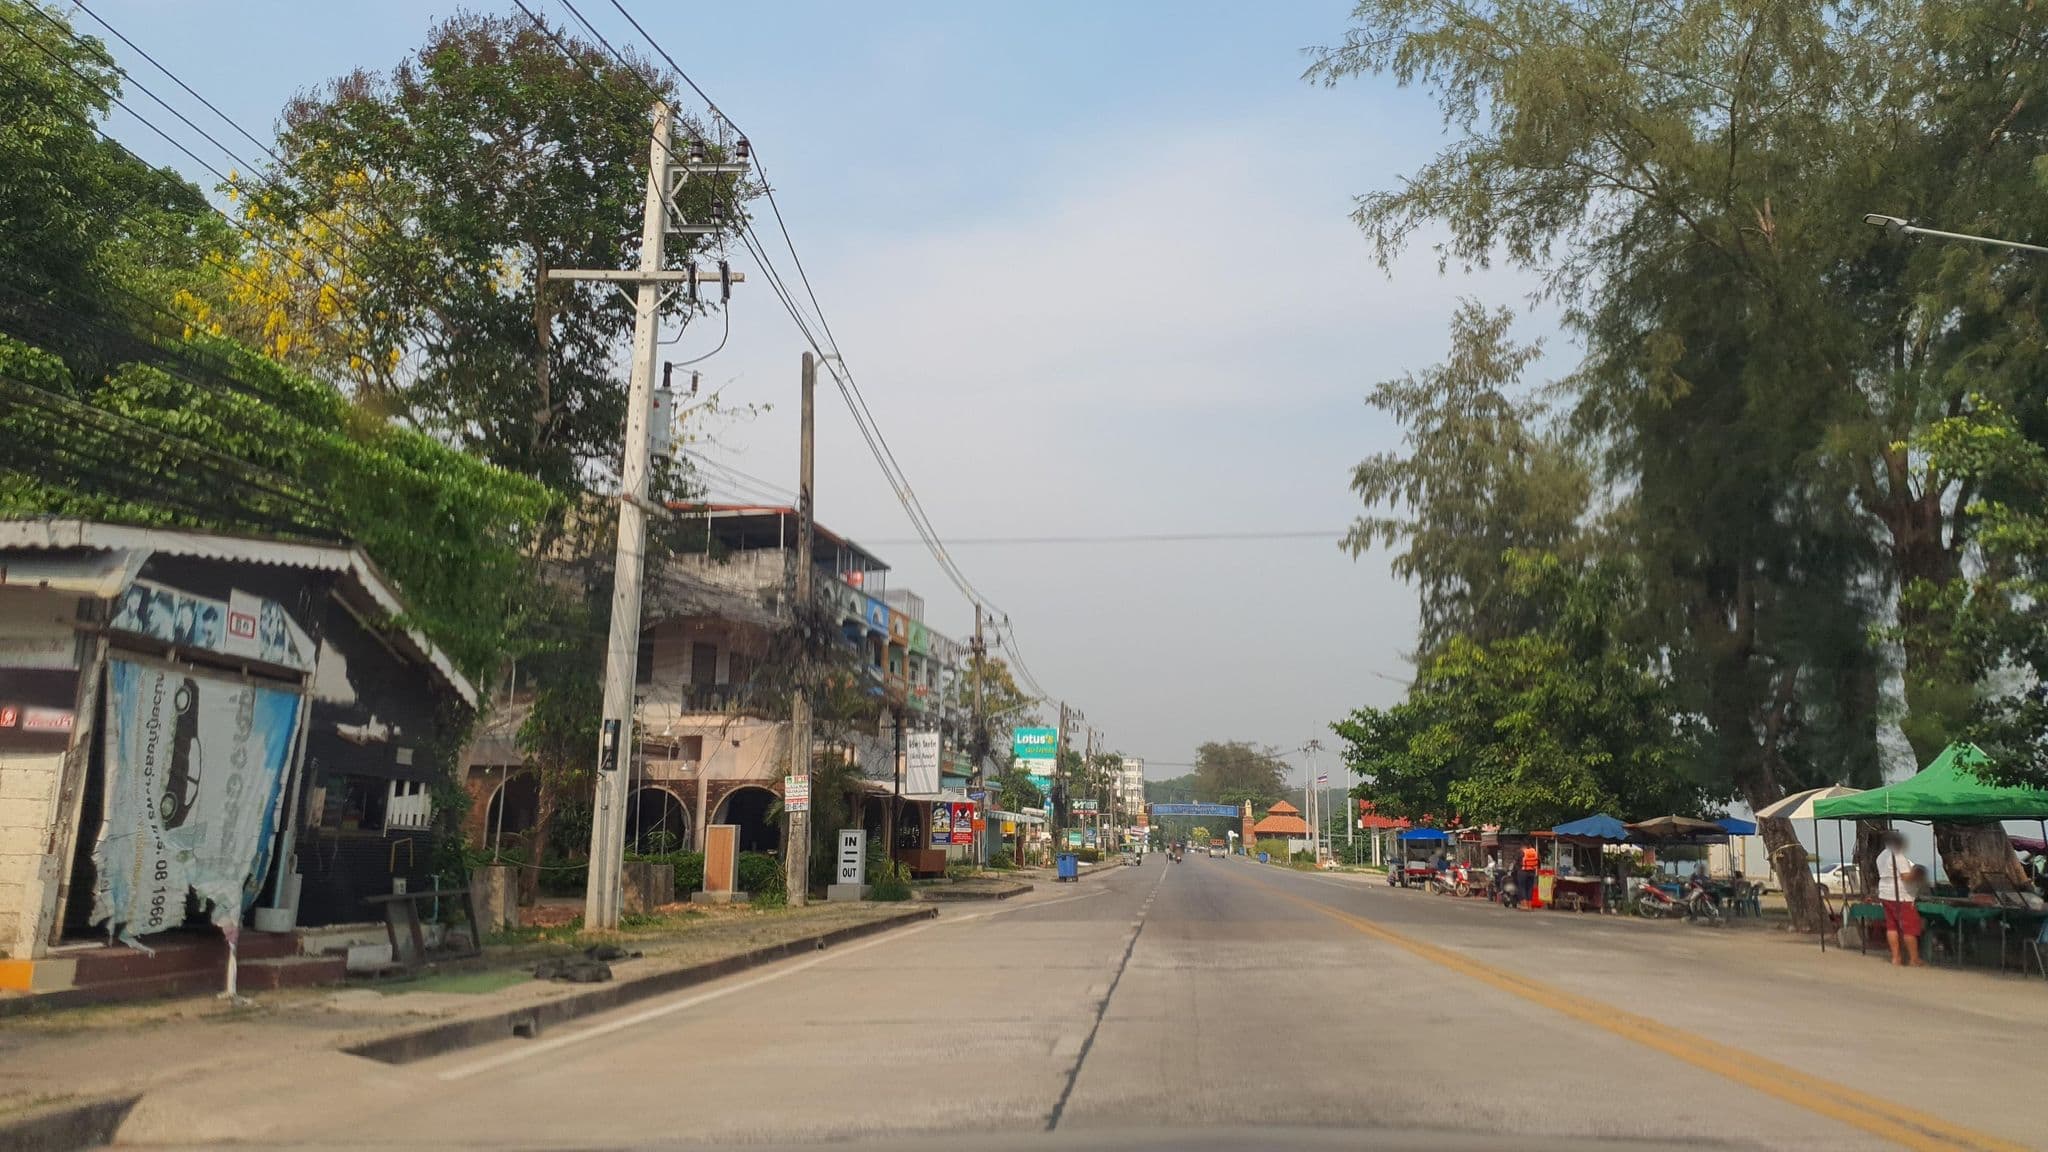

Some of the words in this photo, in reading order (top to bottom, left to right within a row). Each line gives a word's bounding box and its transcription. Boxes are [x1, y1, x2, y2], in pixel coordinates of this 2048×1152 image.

[844, 836, 857, 847] IN
[154, 859, 168, 881] 08
[842, 867, 857, 878] OUT
[148, 886, 166, 927] 1966
